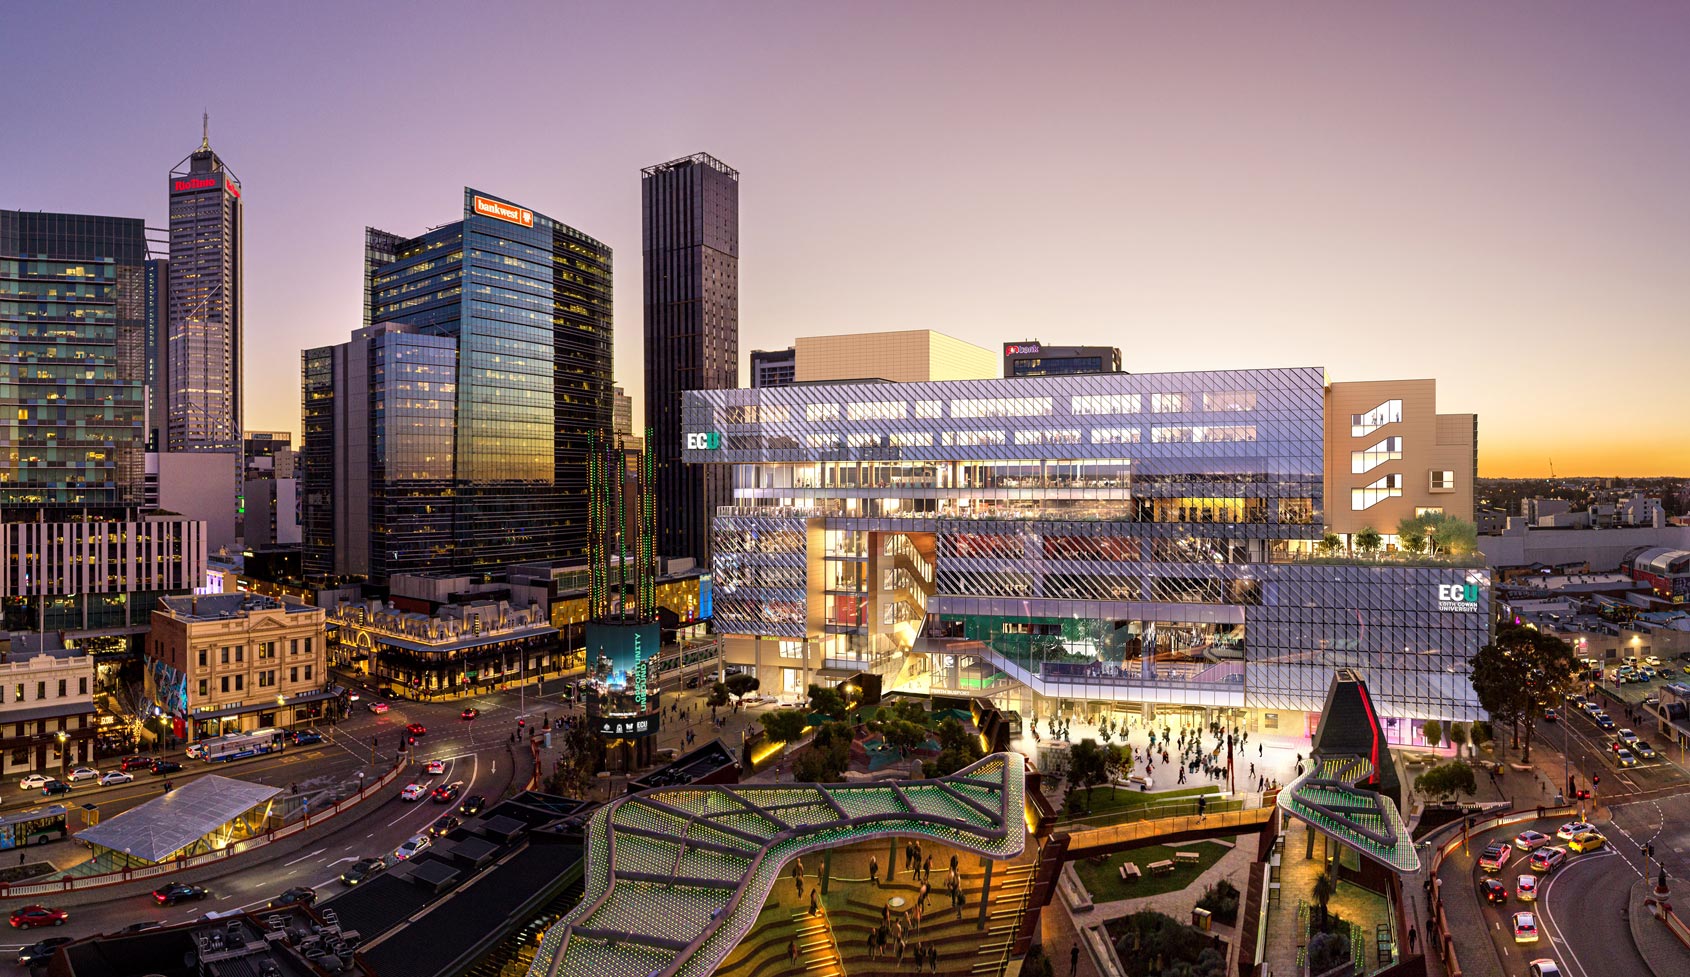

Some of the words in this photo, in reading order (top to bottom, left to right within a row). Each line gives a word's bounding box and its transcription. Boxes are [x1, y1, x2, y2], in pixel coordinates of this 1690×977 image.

[478, 199, 518, 219] bankwest
[687, 432, 718, 449] ECU
[1439, 584, 1478, 601] ECU
